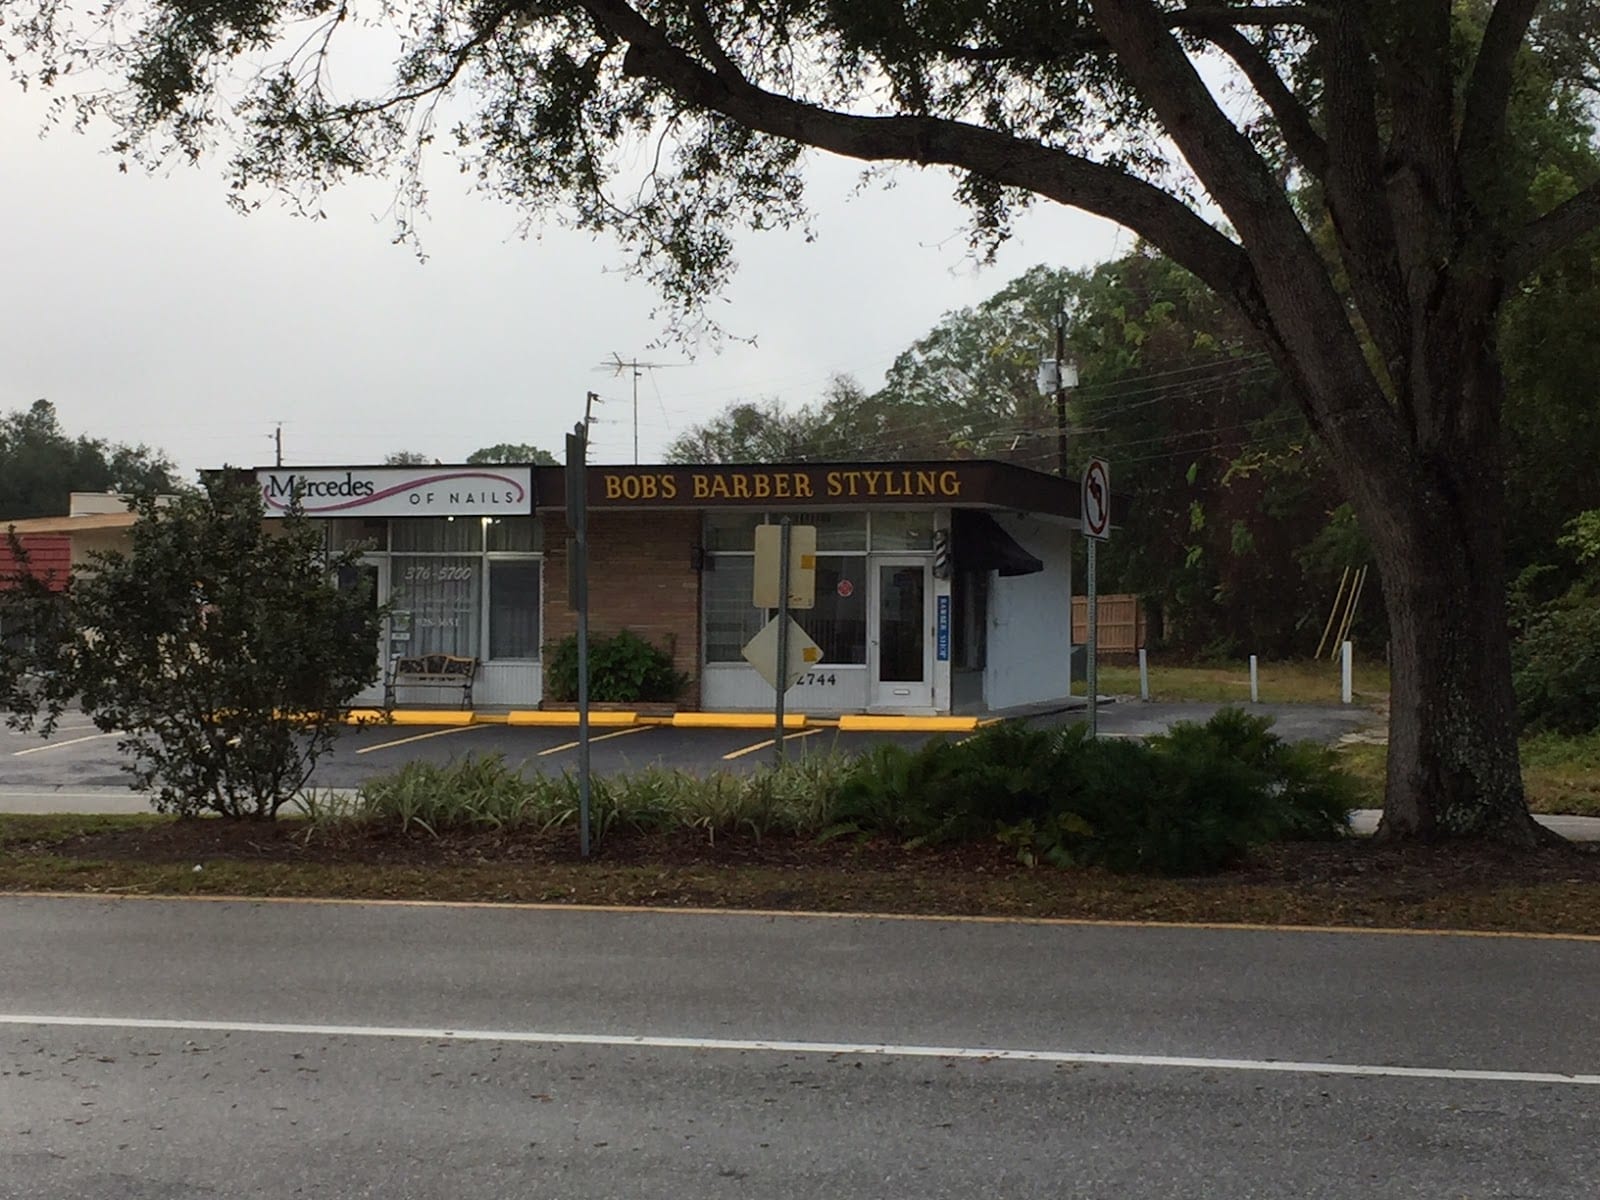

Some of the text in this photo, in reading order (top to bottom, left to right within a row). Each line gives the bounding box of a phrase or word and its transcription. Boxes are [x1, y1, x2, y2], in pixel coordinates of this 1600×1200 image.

[605, 470, 962, 499] BOB'S BARBER STYLING
[409, 491, 513, 505] OF NAILS
